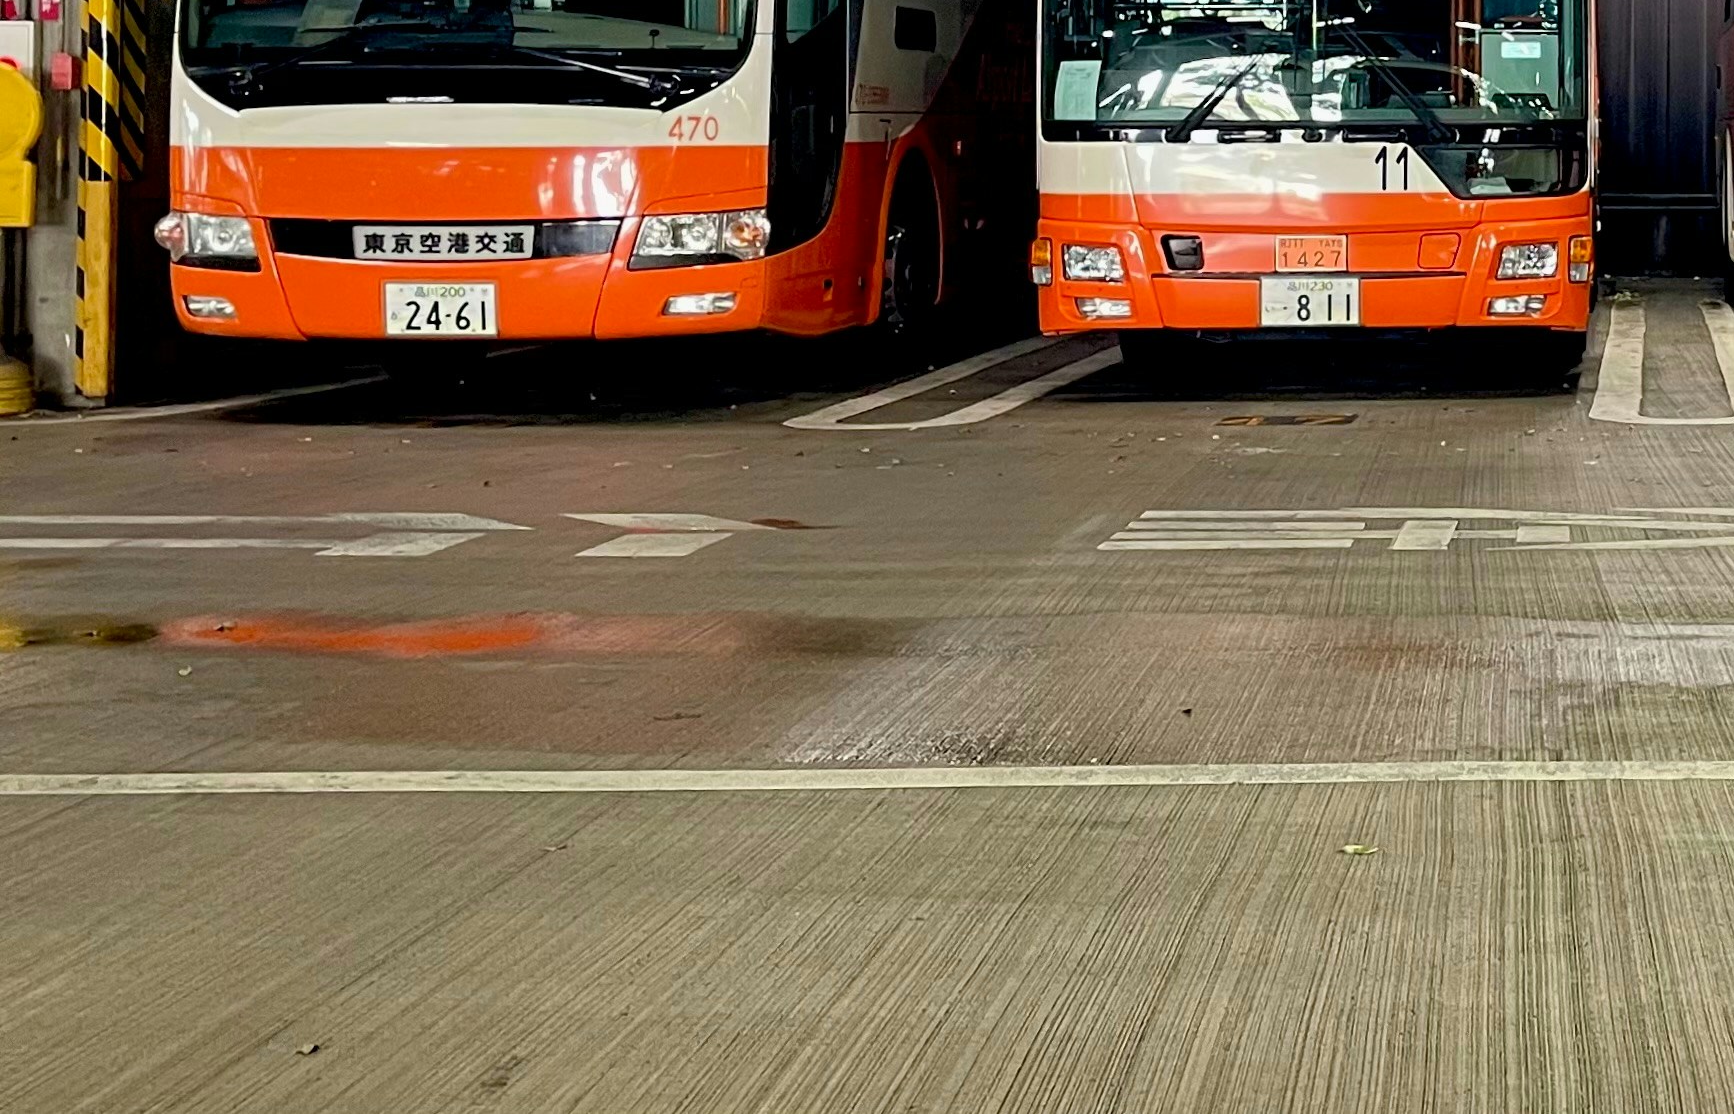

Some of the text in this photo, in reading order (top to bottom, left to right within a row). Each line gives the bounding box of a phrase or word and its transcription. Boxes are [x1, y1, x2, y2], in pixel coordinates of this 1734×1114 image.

[668, 115, 719, 142] 470
[1375, 145, 1409, 191] 11
[362, 231, 526, 255] 東京空港交通
[1281, 250, 1342, 268] 1427
[414, 286, 466, 298] 品川200
[405, 300, 487, 331] 24-61
